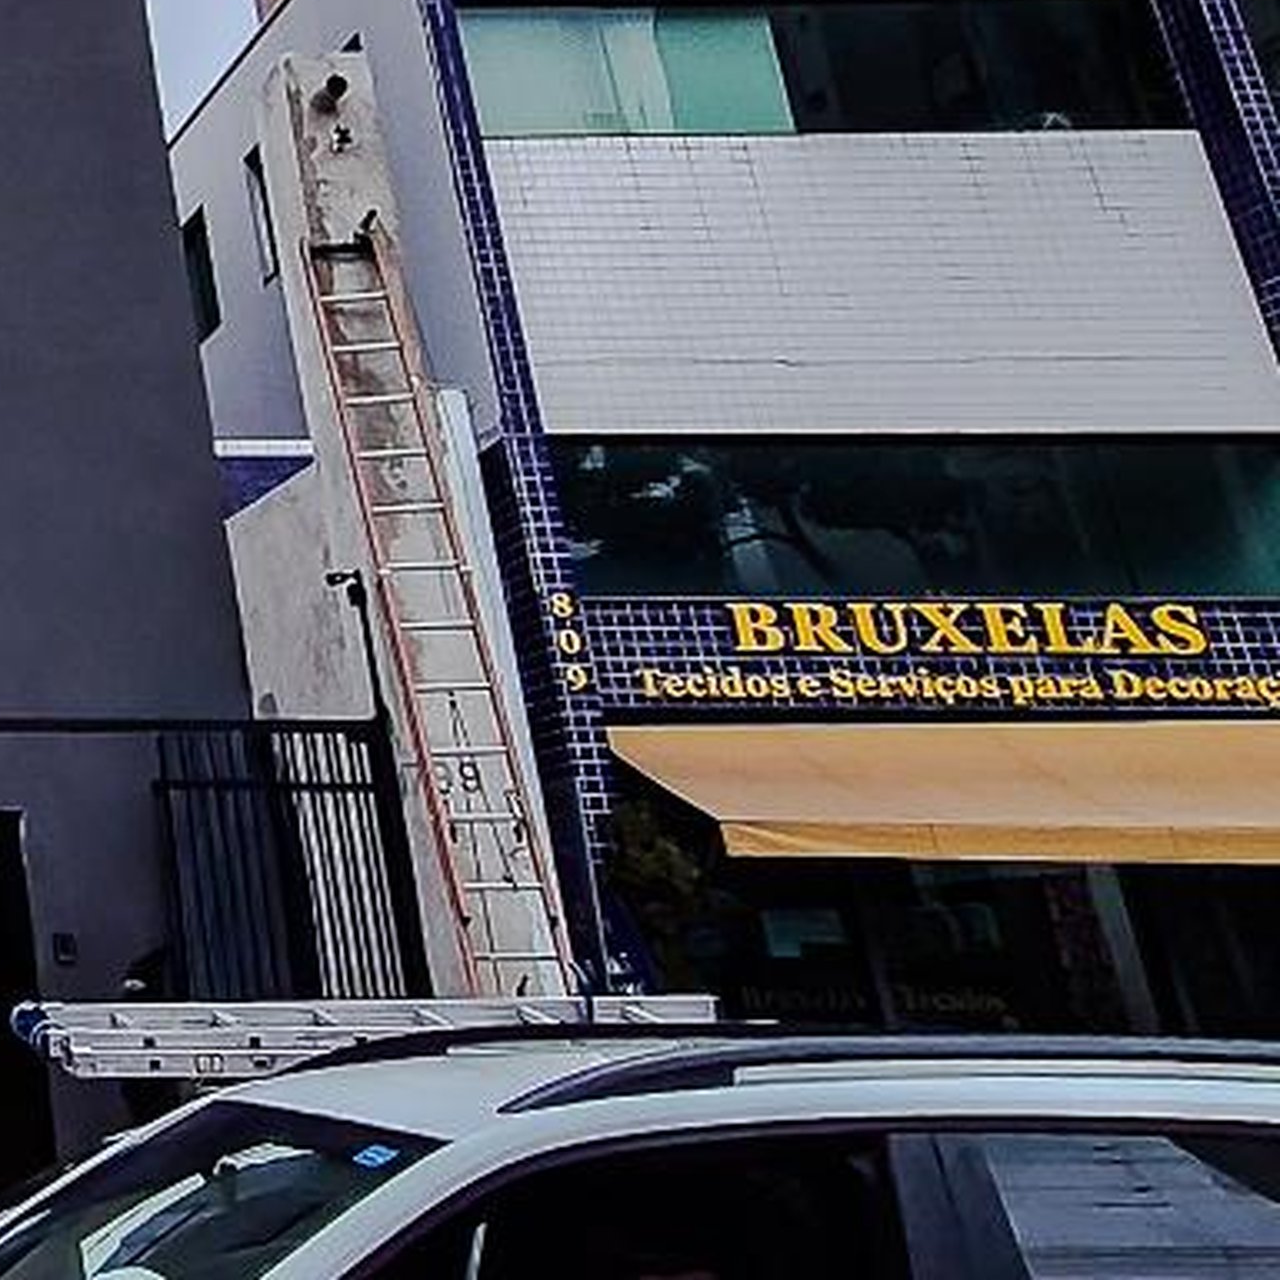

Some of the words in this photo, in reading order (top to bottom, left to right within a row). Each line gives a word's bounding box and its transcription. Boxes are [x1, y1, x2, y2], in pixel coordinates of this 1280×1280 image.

[551, 592, 588, 691] 809
[725, 602, 1208, 655] BRUXELAS
[635, 666, 790, 698] Tecidos
[796, 674, 821, 699] e
[829, 667, 999, 705] Serviços
[1009, 674, 1104, 706] para
